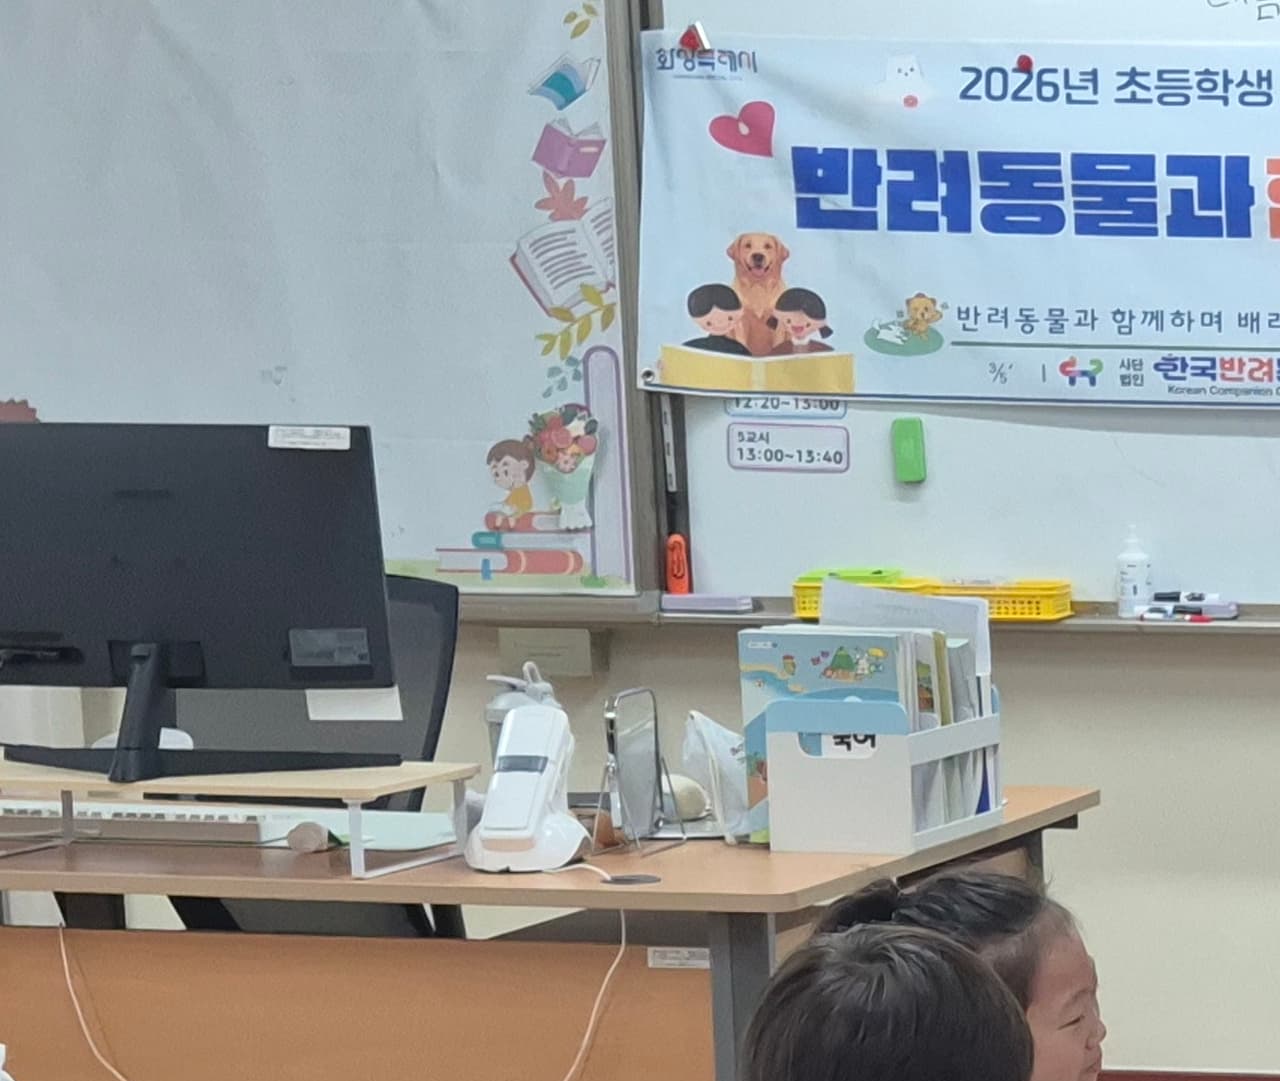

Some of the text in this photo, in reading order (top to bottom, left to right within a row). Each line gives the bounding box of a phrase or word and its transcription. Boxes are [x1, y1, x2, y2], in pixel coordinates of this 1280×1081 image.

[959, 65, 1100, 105] 2026년
[1114, 66, 1274, 107] 초등학생
[791, 145, 1256, 239] 반려동물과
[956, 305, 1098, 336] 반려동물과
[1111, 308, 1224, 336] 함께하며
[1167, 384, 1207, 396] Korean
[737, 431, 770, 445] 5교시
[737, 447, 843, 464] 13:00~13:40
